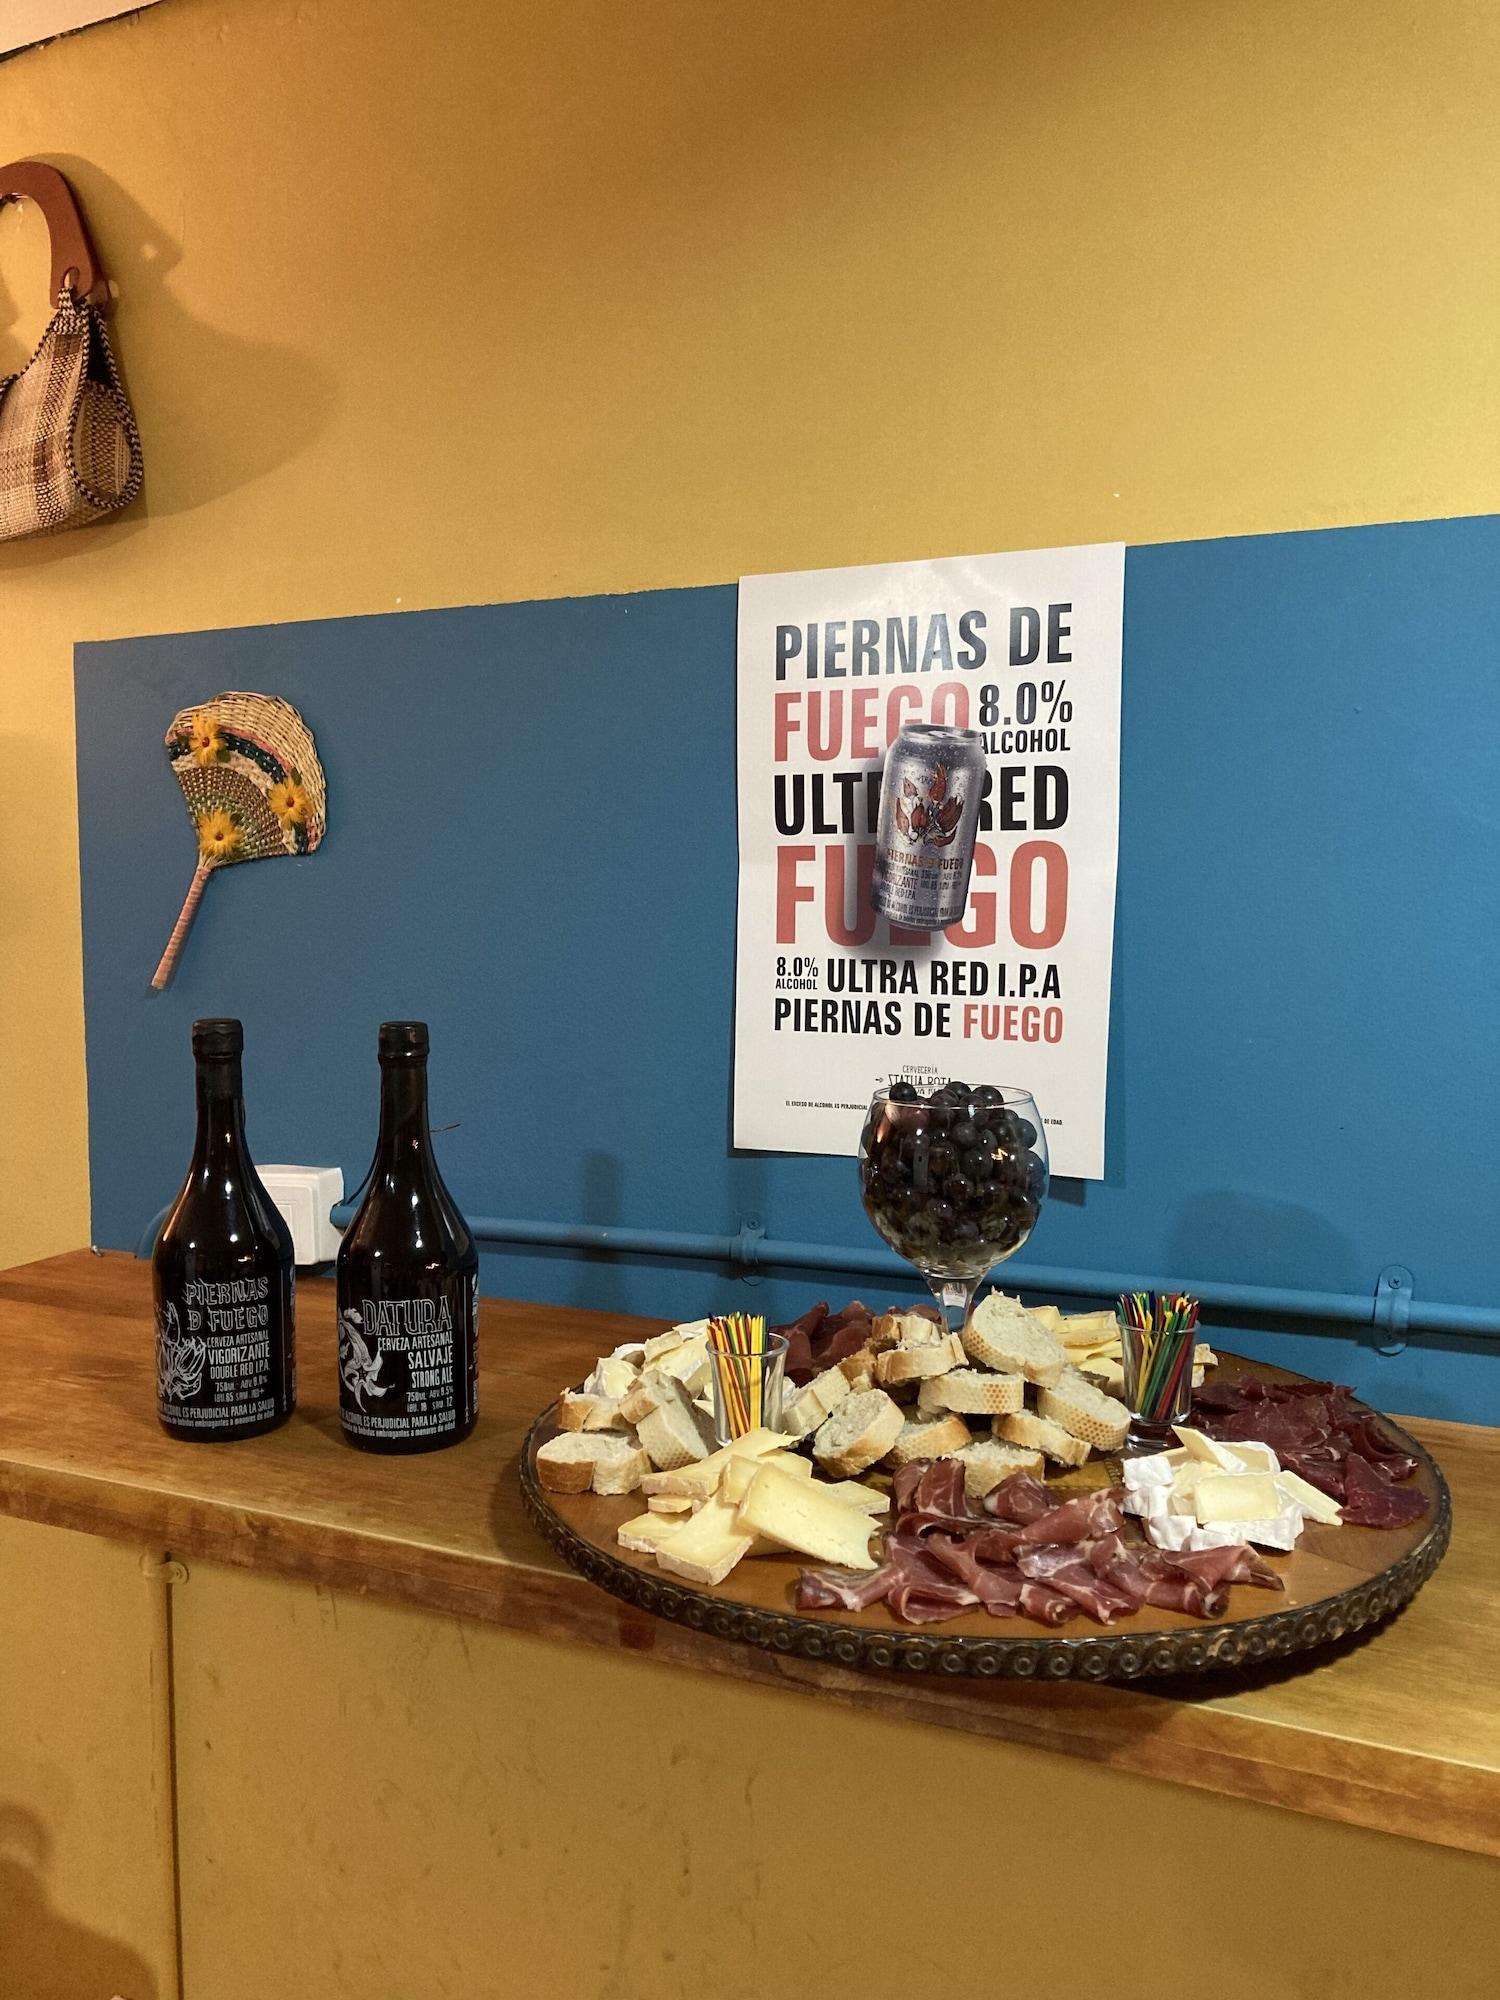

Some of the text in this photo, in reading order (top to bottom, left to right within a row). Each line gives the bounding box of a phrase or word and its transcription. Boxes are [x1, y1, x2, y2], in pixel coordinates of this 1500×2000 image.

[774, 602, 1073, 681] PIERNAS DE
[978, 679, 1073, 728] 8.0%
[773, 771, 883, 836] ULT
[775, 840, 1069, 950] FUGO
[775, 978, 818, 990] ALCOHOL
[776, 956, 1061, 999] 8.0% ULTRA RED I.P.A
[774, 997, 1064, 1044] PIERNAS DE FUEGO
[183, 1276, 269, 1305] PIERNAS
[207, 1304, 270, 1333] FUEGO
[362, 1295, 453, 1337] DATURA
[206, 1329, 270, 1349] CERVEZA ARTESANAL
[377, 1330, 454, 1352] CERVEZA ARTESANAL
[207, 1340, 271, 1366] VIGORIZANTE
[407, 1344, 454, 1370] SALVAJE
[210, 1364, 239, 1380] DOUBLE
[239, 1361, 254, 1377] RED
[411, 1365, 454, 1389] STRONG ALE
[189, 1406, 230, 1420] PERJUDICIAL
[230, 1404, 248, 1418] PARA
[248, 1402, 257, 1414] LA
[363, 1415, 371, 1428] ES
[371, 1416, 411, 1430] PERJUDICIAL
[411, 1414, 429, 1429] PARA
[429, 1413, 439, 1426] LA
